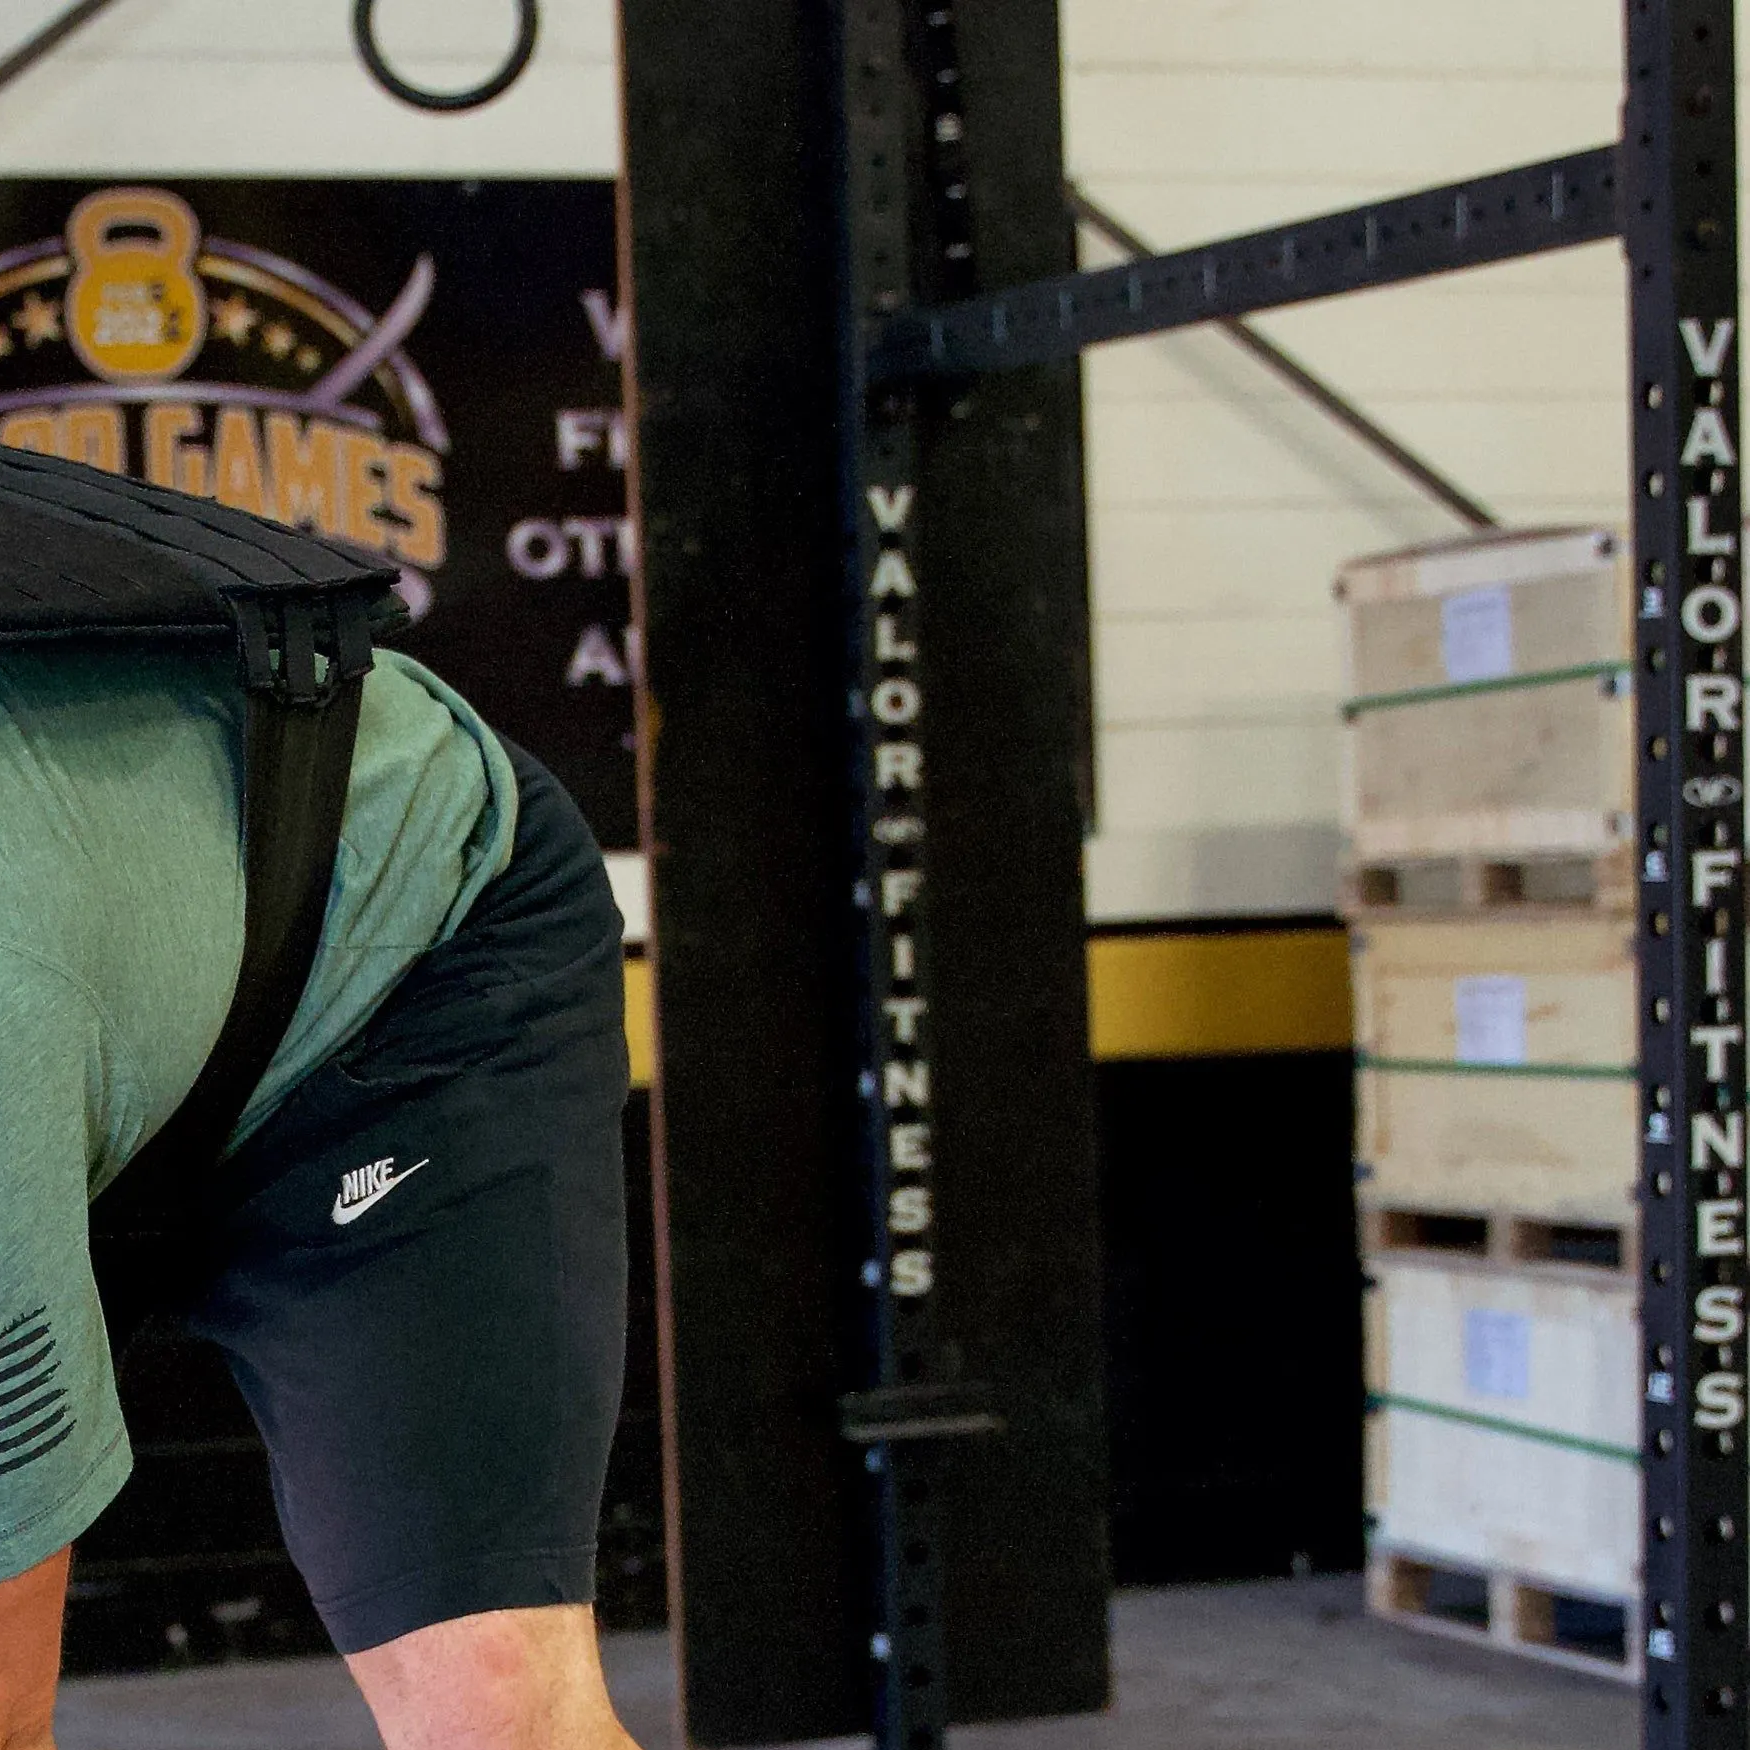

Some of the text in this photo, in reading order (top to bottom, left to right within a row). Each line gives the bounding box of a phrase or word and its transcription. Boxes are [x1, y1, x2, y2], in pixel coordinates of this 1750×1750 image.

[145, 403, 446, 570] GAMES
[865, 484, 923, 791] VALOR
[1679, 318, 1741, 732] VALOR
[341, 1157, 395, 1205] NIKE
[879, 869, 934, 1297] FITNESS
[1689, 852, 1745, 1429] FITNESS
